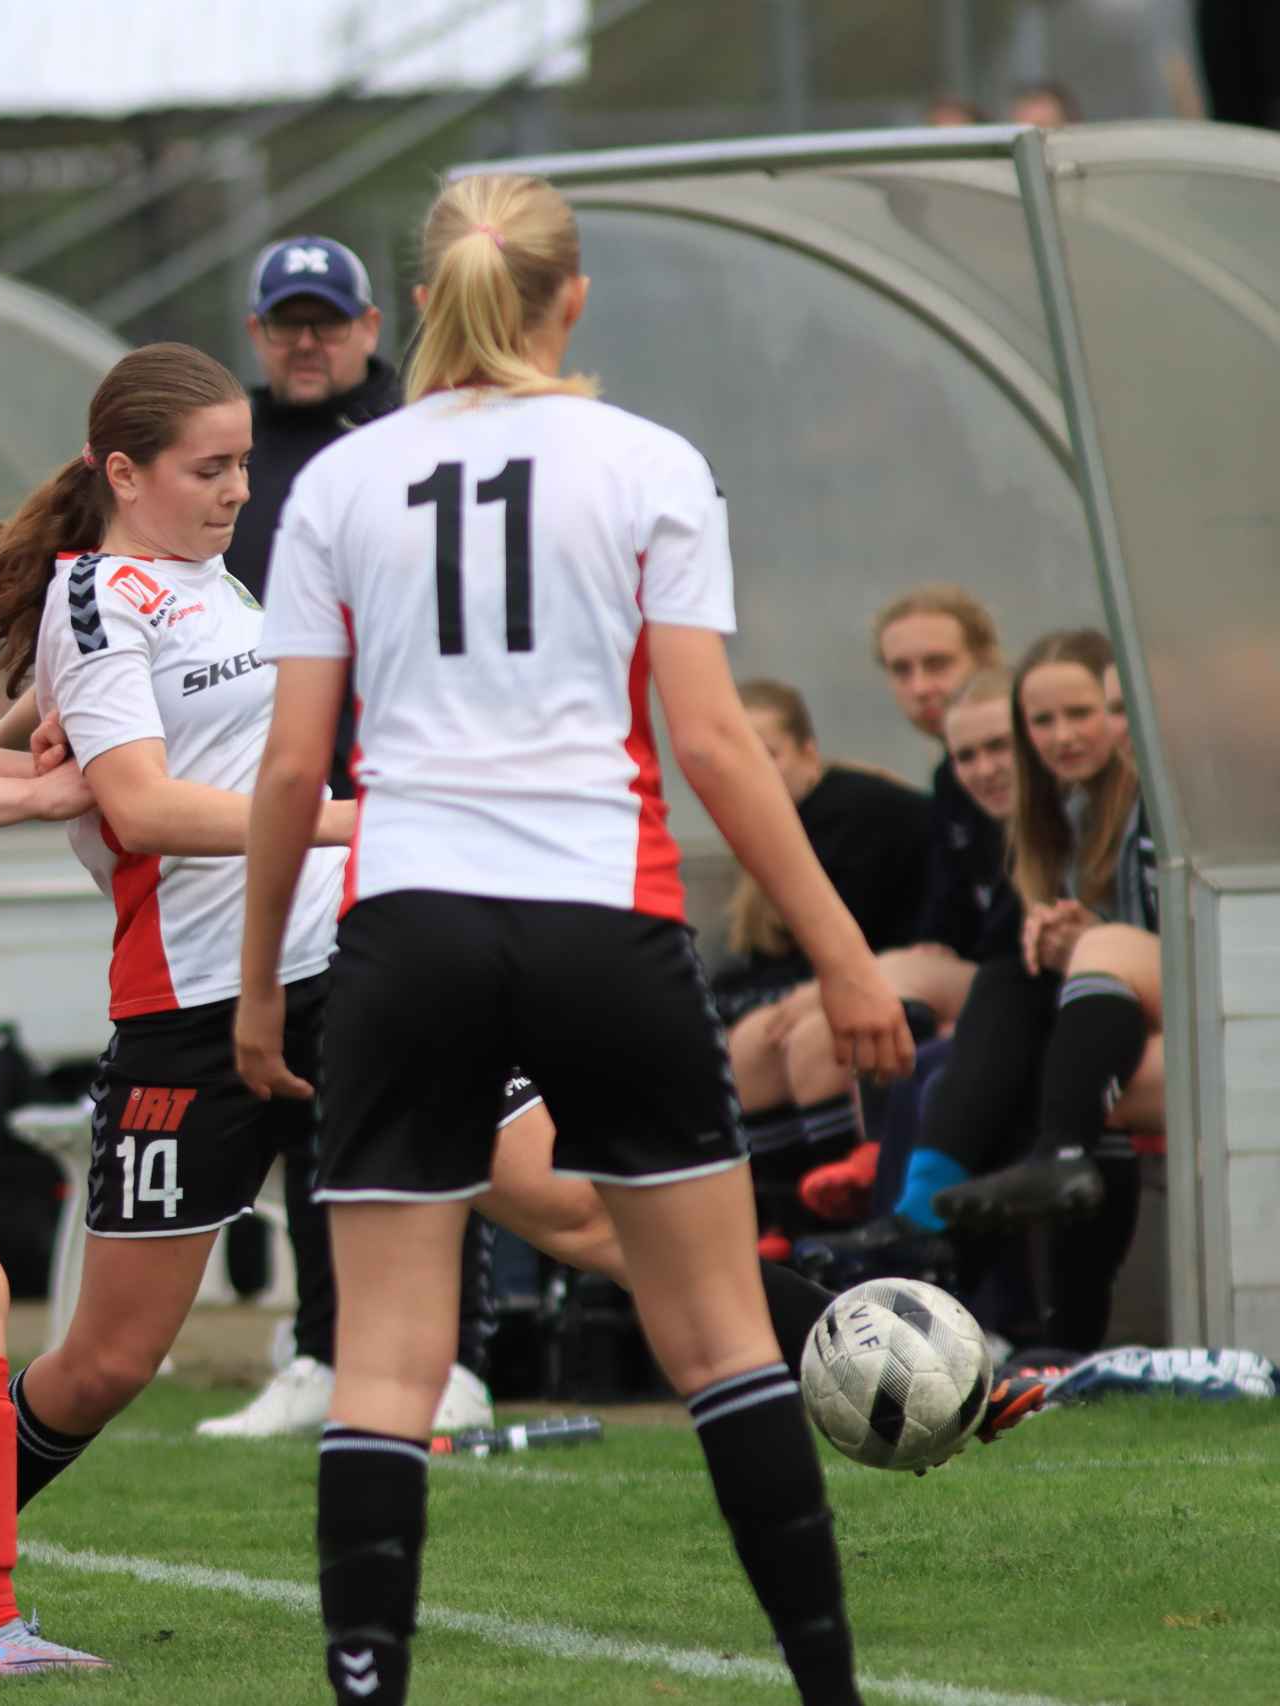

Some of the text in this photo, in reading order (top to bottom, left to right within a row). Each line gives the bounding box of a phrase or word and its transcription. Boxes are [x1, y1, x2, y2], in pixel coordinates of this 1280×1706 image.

[406, 457, 536, 656] 11
[116, 1136, 184, 1219] 14
[848, 1304, 881, 1350] VIF
